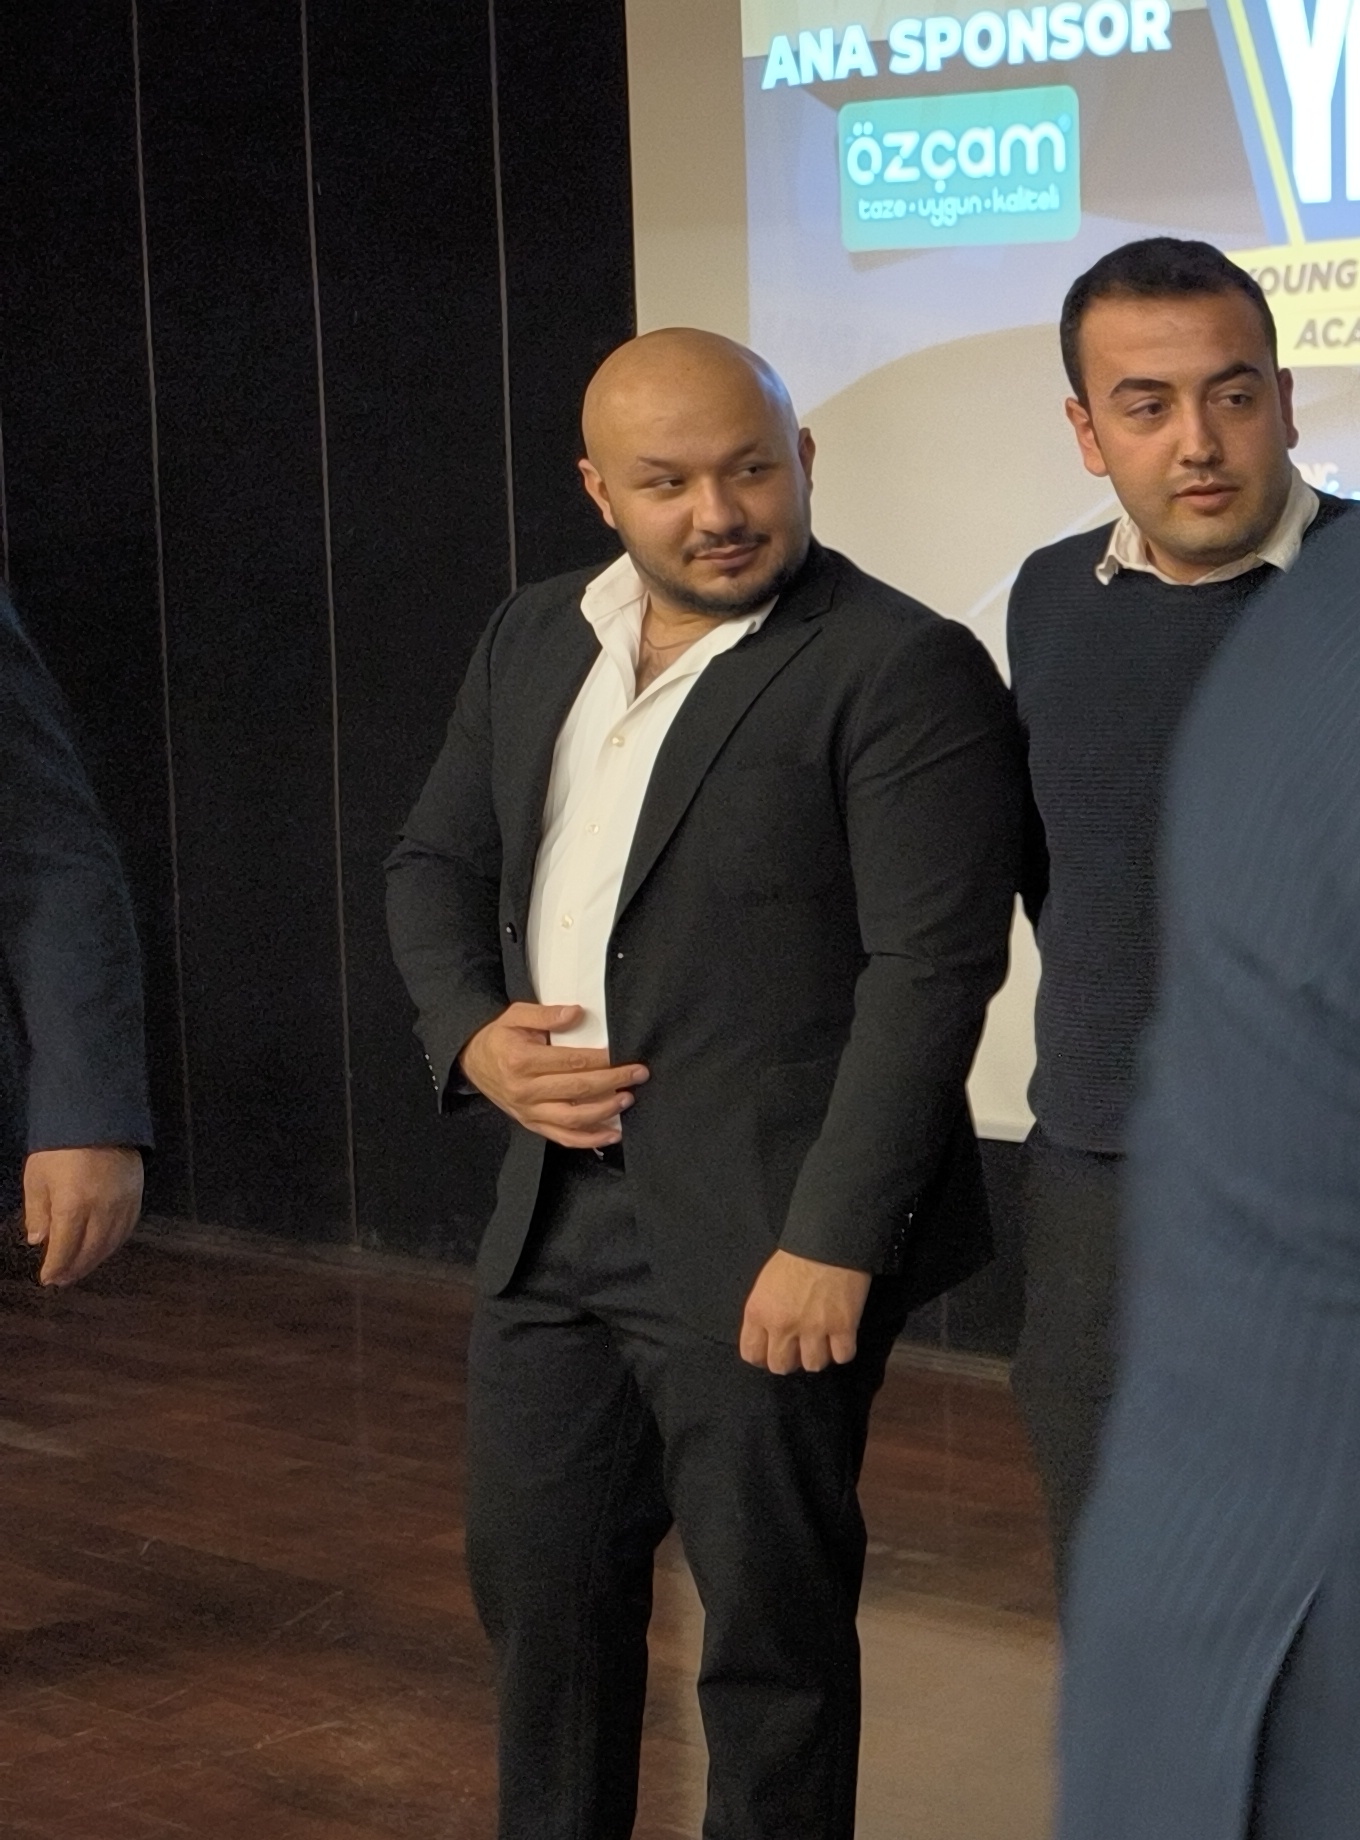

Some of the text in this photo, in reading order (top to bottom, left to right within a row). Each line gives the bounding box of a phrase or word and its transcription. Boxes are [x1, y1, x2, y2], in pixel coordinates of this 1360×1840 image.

[761, 0, 1172, 90] ANA SPONSOR
[847, 121, 1066, 194] özçam
[918, 194, 983, 227] uygun
[1251, 258, 1358, 298] OUNG
